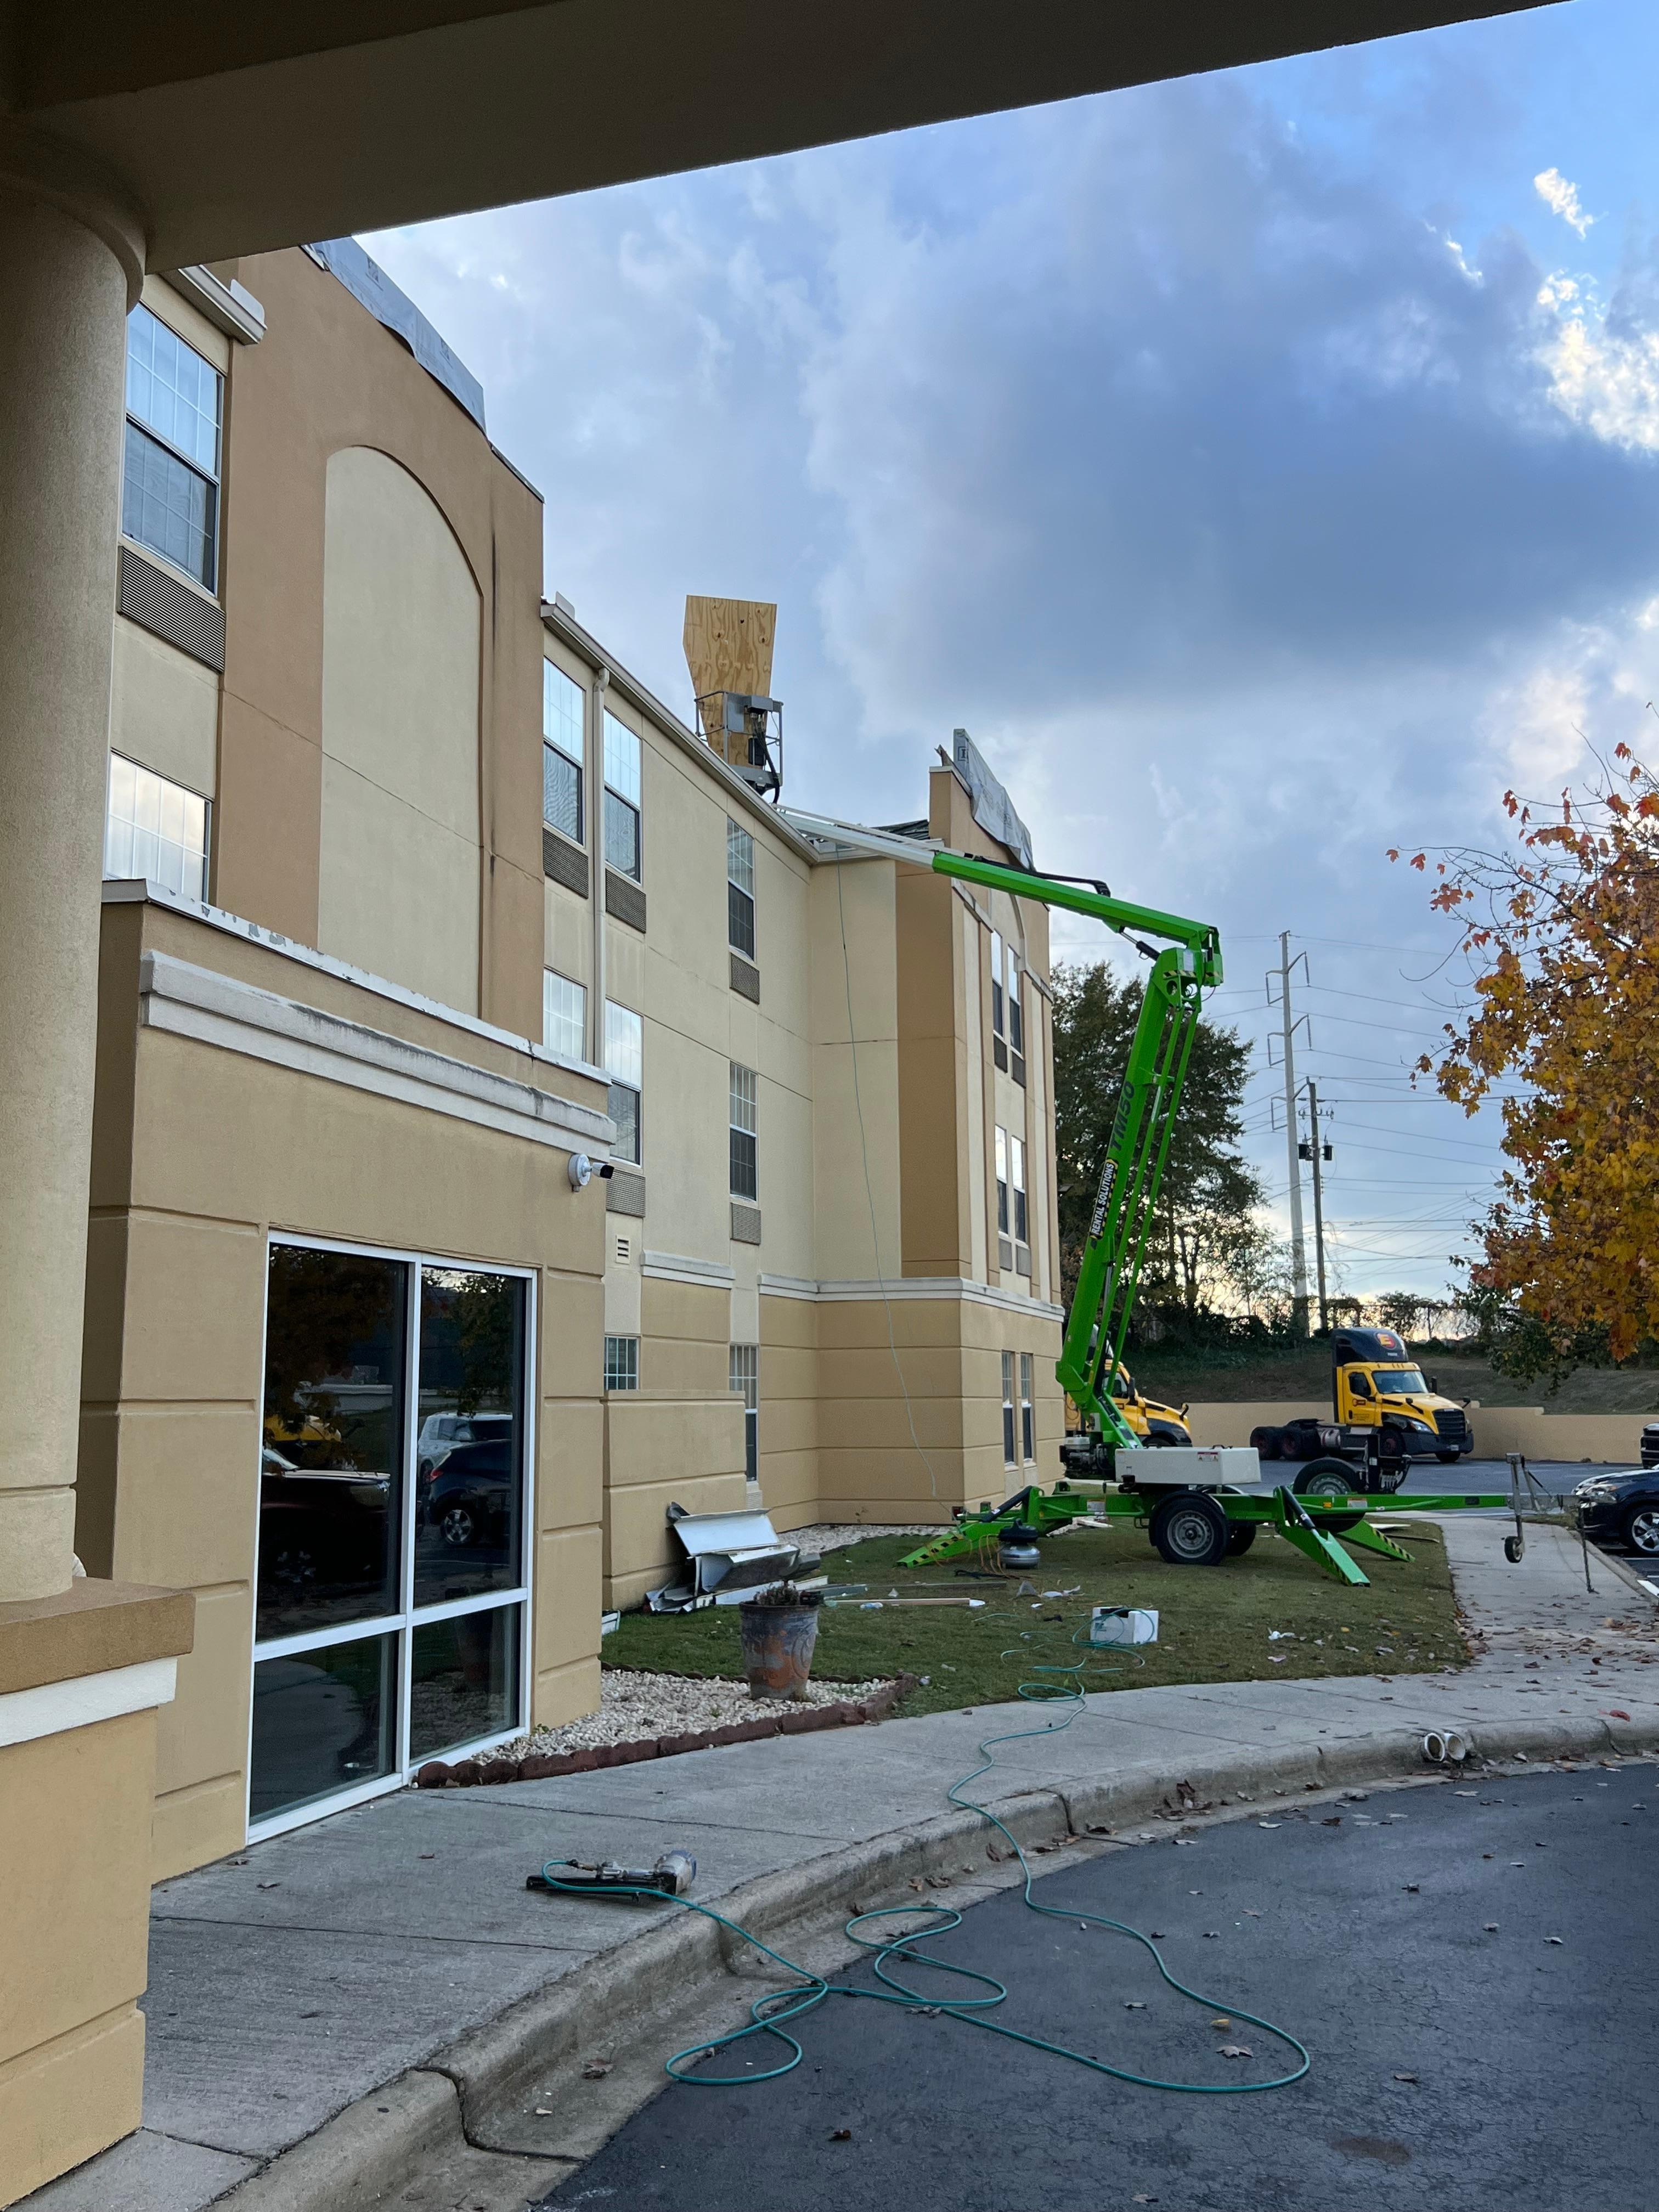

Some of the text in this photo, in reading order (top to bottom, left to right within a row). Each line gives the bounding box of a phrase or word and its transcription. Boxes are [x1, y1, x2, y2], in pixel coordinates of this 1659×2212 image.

[1110, 1080, 1135, 1151] TM50
[1091, 1163, 1115, 1234] RENTAL SOLUTIONS
